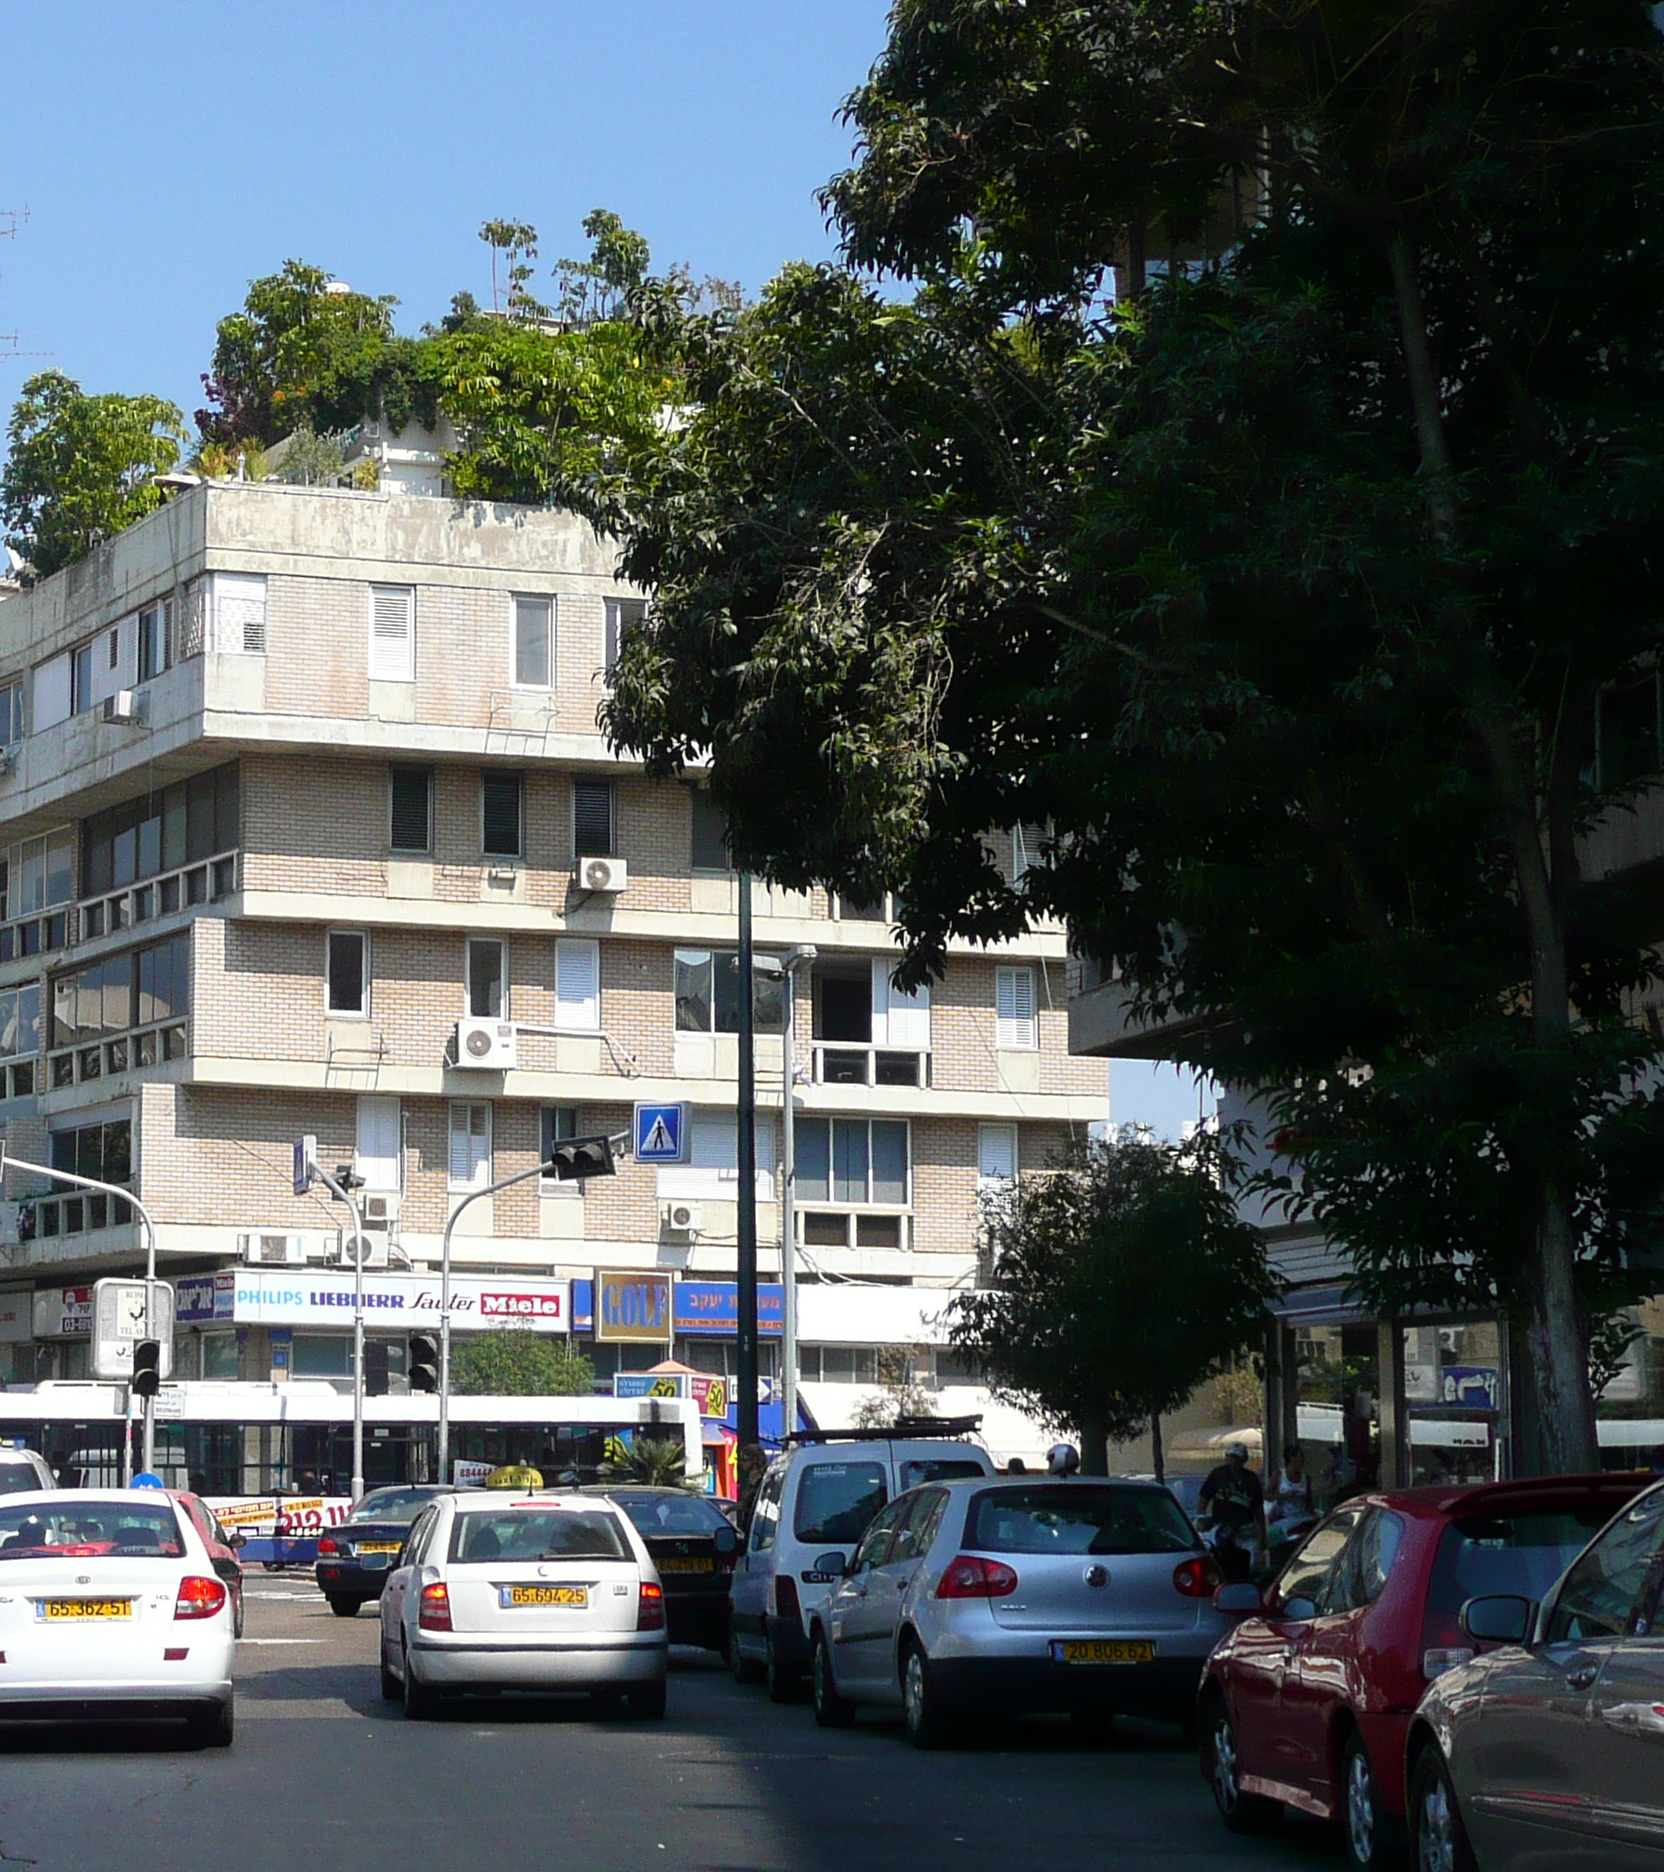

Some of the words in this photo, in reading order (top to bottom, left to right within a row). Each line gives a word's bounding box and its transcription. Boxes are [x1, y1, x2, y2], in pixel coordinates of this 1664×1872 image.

[237, 1290, 303, 1306] PHILIPS
[310, 1291, 405, 1309] LIEBHERR
[483, 1295, 557, 1314] Miele
[603, 1283, 669, 1328] GOLF
